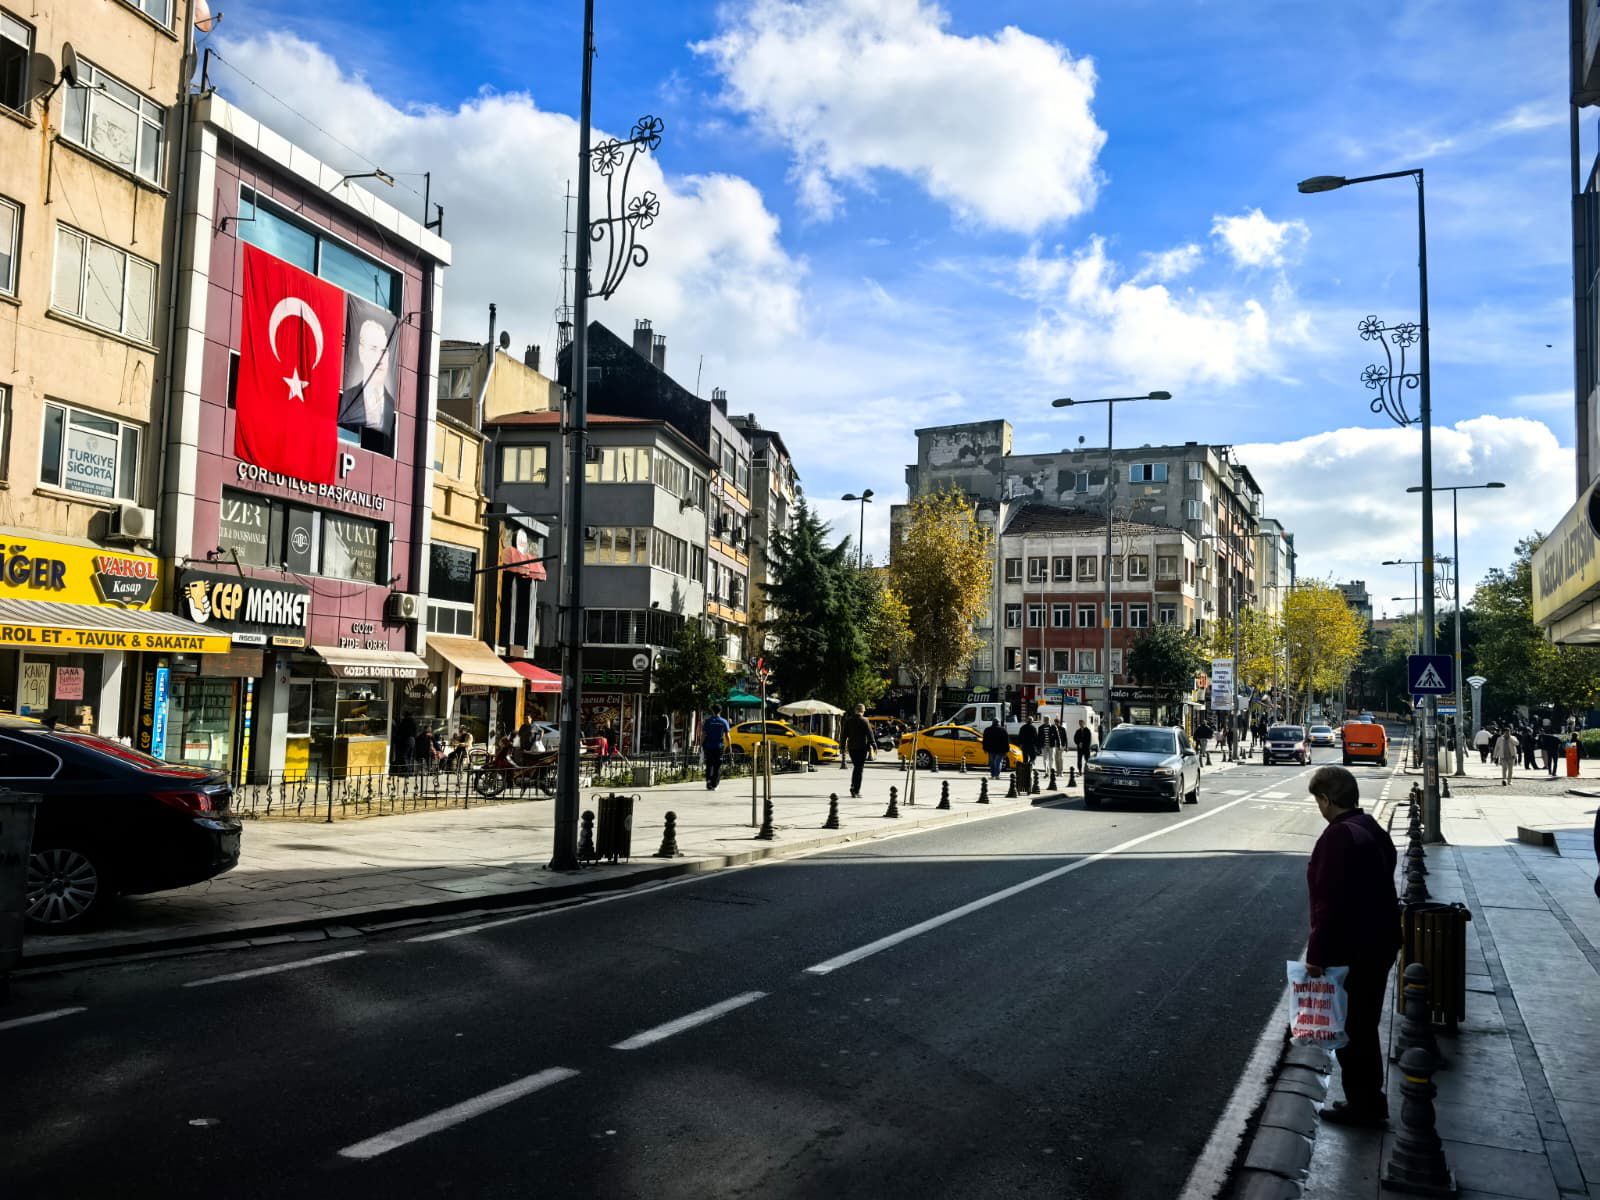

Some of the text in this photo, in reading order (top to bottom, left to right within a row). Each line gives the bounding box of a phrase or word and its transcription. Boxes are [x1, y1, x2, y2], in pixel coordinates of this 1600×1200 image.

[67, 460, 113, 480] SİGORTA
[238, 462, 285, 486] ÇORLU
[98, 556, 157, 579] VAROL
[113, 580, 142, 593] Kasap
[211, 582, 311, 627] CEP MARKET
[0, 627, 37, 642] ROL
[41, 630, 62, 643] ET
[76, 631, 126, 647] TAVUK
[131, 634, 141, 647] &
[146, 636, 205, 650] SAKATAT
